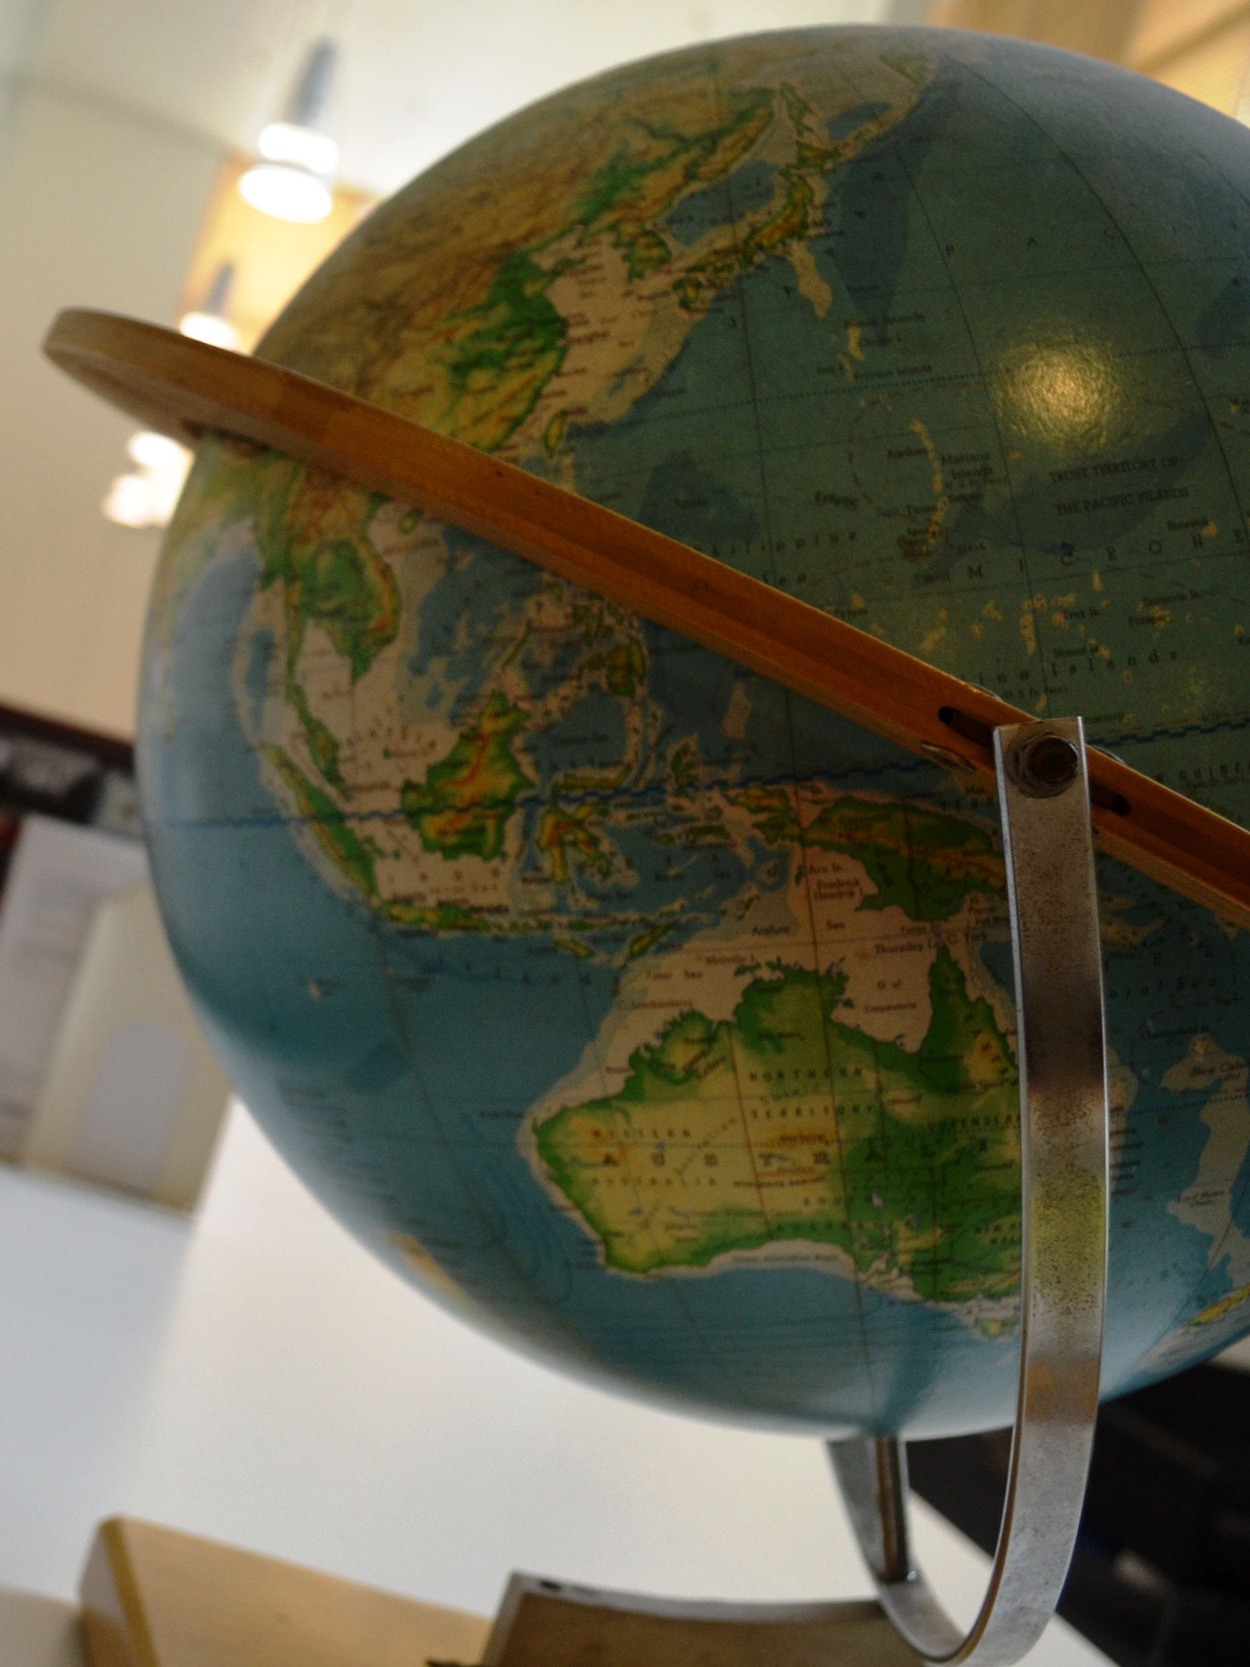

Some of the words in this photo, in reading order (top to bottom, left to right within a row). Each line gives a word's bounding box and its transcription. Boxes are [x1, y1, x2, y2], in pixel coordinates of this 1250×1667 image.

[941, 453, 991, 466] Mariana
[1049, 467, 1088, 483] TRUST
[1091, 457, 1157, 478] TERRITORY
[1161, 455, 1179, 469] OF
[1055, 501, 1081, 516] THE
[1083, 492, 1135, 514] PACIFIC
[1136, 486, 1189, 504] ISLANDS
[1052, 648, 1178, 678] Islands
[826, 919, 846, 931] Sea
[875, 942, 924, 954] Thursday
[749, 1066, 863, 1083] NORTHERN
[1191, 1064, 1216, 1078] New
[751, 1102, 873, 1120] TERRITORY
[591, 1127, 691, 1140] WESTERN
